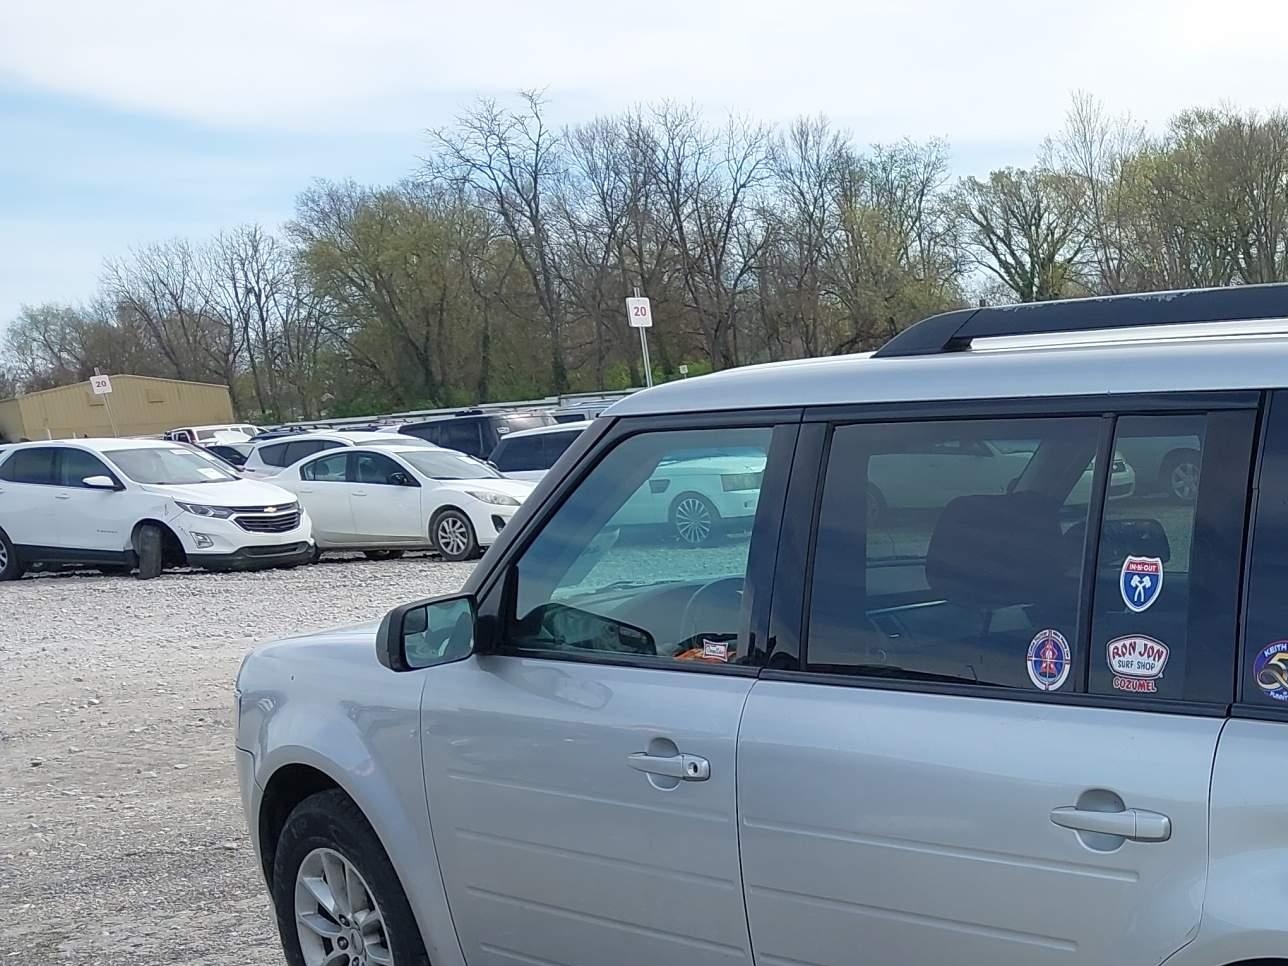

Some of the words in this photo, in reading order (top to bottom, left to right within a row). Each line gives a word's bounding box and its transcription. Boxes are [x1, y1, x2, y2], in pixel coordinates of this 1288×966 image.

[633, 306, 647, 317] 20
[95, 380, 107, 388] 20
[1129, 563, 1157, 572] IN-N-OUT
[1112, 640, 1137, 661] RON
[1138, 641, 1164, 663] JON
[1263, 643, 1288, 658] KEITH
[1117, 659, 1134, 669] SURF
[1136, 660, 1156, 671] SHOP
[1113, 677, 1157, 692] COZUMEL
